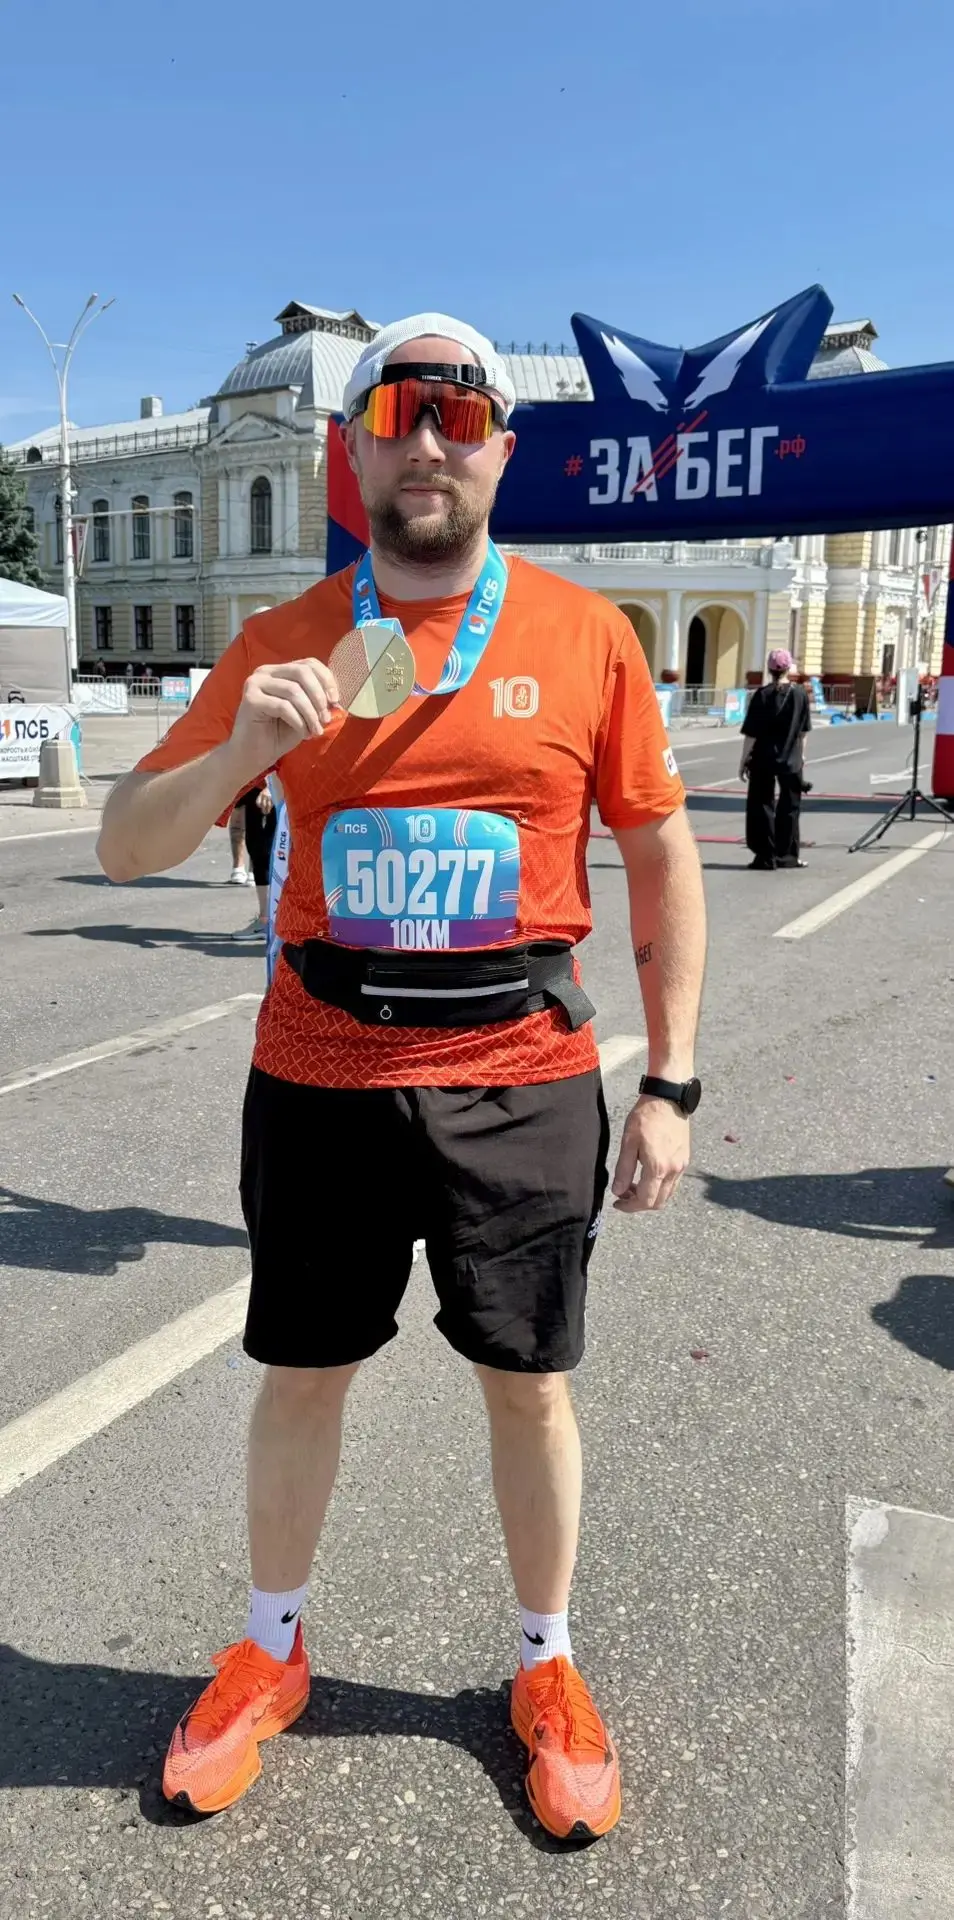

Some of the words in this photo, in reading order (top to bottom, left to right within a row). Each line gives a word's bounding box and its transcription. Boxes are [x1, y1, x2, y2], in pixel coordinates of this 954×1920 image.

[359, 598, 374, 620] ПС
[476, 577, 499, 615] ПСБ
[488, 675, 540, 719] 10
[15, 719, 49, 739] ПСБ
[344, 823, 368, 834] ПСБ
[405, 813, 436, 843] 10
[346, 849, 495, 916] 50277
